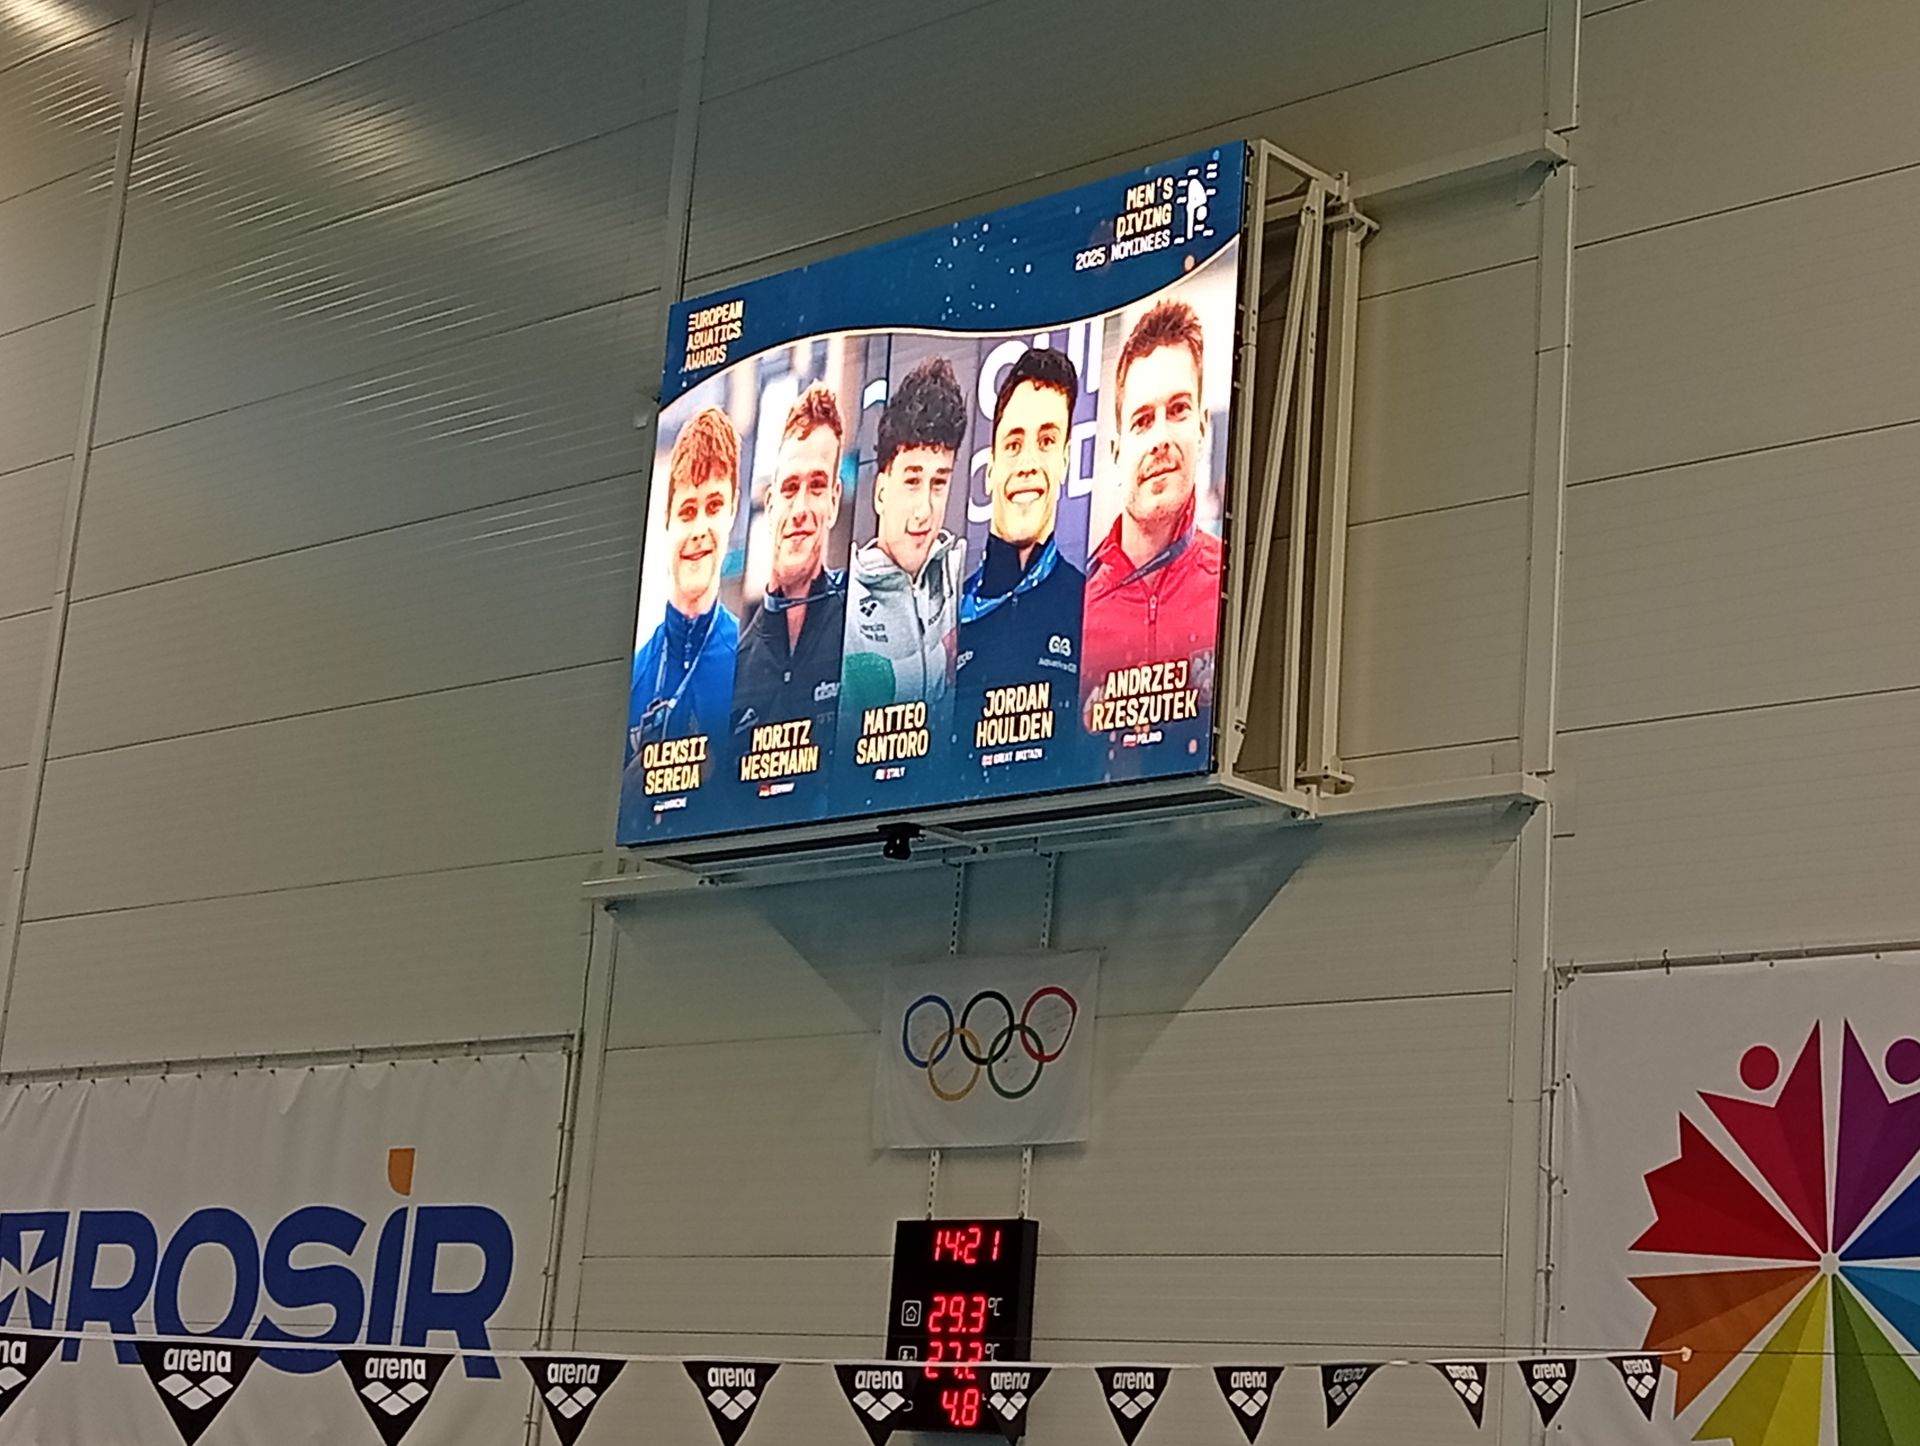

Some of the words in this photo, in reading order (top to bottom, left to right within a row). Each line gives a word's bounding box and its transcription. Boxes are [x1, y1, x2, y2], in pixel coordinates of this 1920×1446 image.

[1126, 177, 1174, 210] MEN'S
[1115, 203, 1172, 239] DIVING
[1075, 247, 1106, 271] 2025
[1110, 229, 1171, 261] NOMINEES
[688, 300, 744, 331] EUROPEAN
[686, 320, 742, 351] AQUATICS
[683, 344, 727, 372] AWARDS
[1104, 660, 1189, 699] ANDRZEJ
[983, 682, 1050, 717] JORDAN
[1092, 689, 1199, 731] RZESZUTEK
[863, 702, 926, 735] MATTEO
[976, 711, 1053, 747] HOULDEN
[752, 719, 811, 753] MORITZ
[856, 729, 929, 765] SANTORO
[643, 736, 708, 769] OLEKSII
[644, 764, 700, 795] SEREDA
[934, 1227, 1000, 1264] 14:21
[928, 1296, 986, 1333] 29.3
[164, 1348, 232, 1373] arena
[365, 1357, 427, 1380] arena
[547, 1362, 600, 1384] arena
[1532, 1363, 1566, 1379] arena
[1622, 1359, 1653, 1374] arena
[707, 1367, 756, 1387] arena
[855, 1370, 903, 1389] arena
[990, 1371, 1031, 1390] arena
[1113, 1372, 1155, 1389] arena
[1231, 1371, 1267, 1388] arena
[942, 1388, 979, 1426] 4.8
